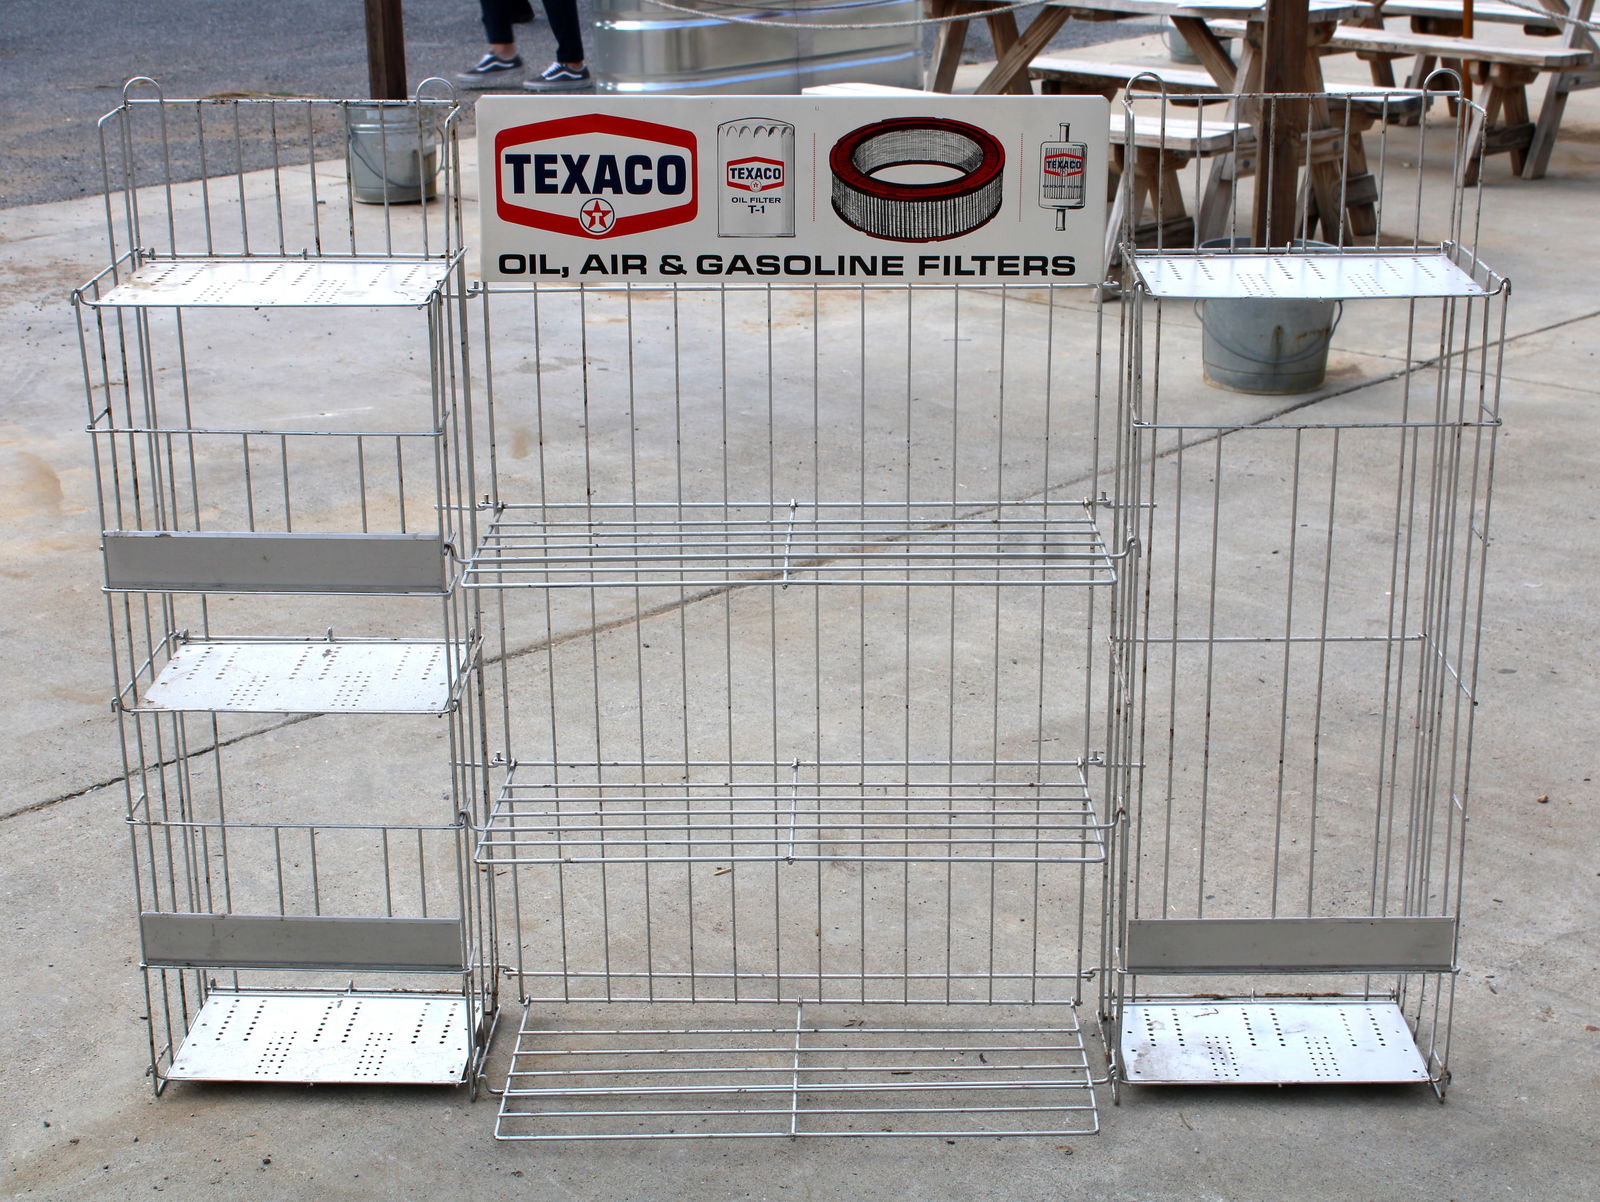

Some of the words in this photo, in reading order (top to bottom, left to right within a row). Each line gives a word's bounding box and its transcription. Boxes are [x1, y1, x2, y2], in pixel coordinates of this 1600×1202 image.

[1046, 160, 1082, 169] TEXACO
[505, 154, 686, 195] TEXACO
[729, 167, 782, 180] TEXACO
[731, 196, 748, 204] OIL
[750, 196, 782, 204] FILTER
[747, 204, 765, 214] T-1
[498, 254, 569, 278] OIL,
[580, 254, 647, 275] AIR
[659, 254, 687, 276] &
[696, 254, 904, 276] GASOLINE
[918, 255, 1076, 276] FILTERS
